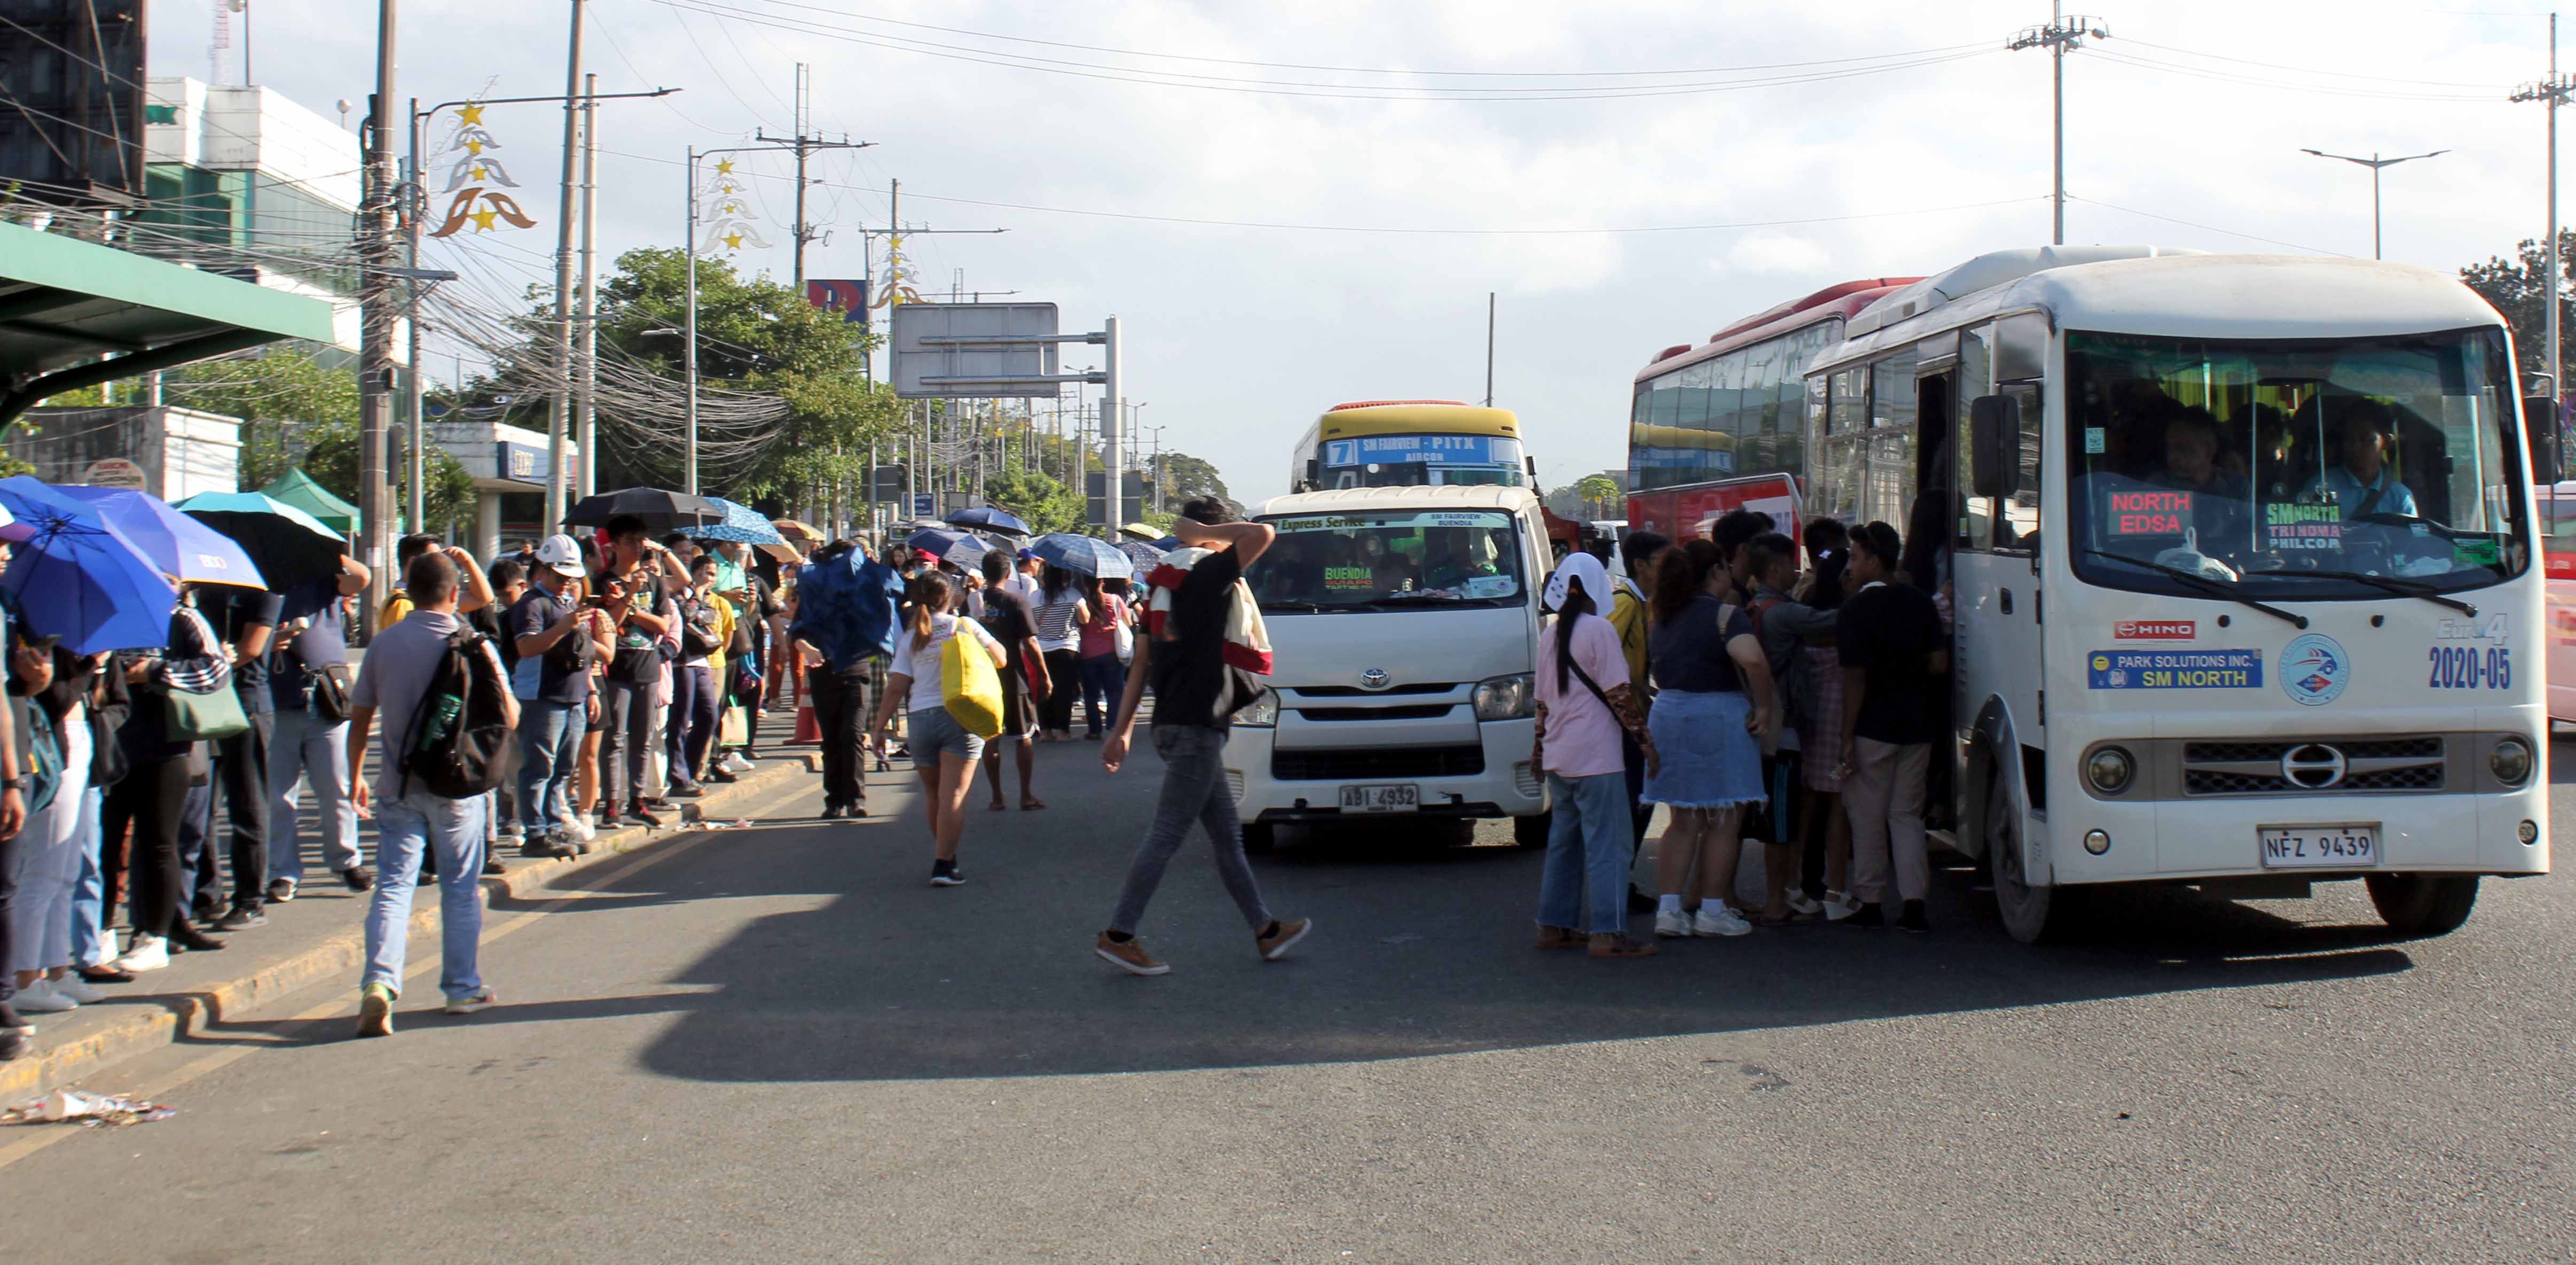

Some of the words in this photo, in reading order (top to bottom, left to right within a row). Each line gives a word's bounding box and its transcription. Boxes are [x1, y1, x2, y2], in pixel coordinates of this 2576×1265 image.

[1379, 437, 1419, 450] FAIRVIEW
[1432, 436, 1475, 449] PITX
[1333, 444, 1349, 464] 7
[1405, 452, 1444, 462] AIRCON
[2112, 493, 2190, 511] NORTH
[1282, 520, 1322, 532] Express
[1326, 517, 1365, 527] Service
[2121, 514, 2182, 533] EDSA
[1325, 567, 1372, 580] BUENDIA
[2139, 625, 2192, 634] HINO
[2484, 613, 2508, 645] 4
[2118, 655, 2152, 667] PARK
[2155, 655, 2226, 667] SOLUTIONS
[2229, 655, 2253, 667] INC.
[2430, 647, 2511, 689] 2020-05
[2142, 670, 2172, 687] SM
[2178, 670, 2247, 686] NORTH
[1378, 787, 1415, 805] 4932
[2267, 838, 2306, 857] NFZ
[2320, 836, 2369, 856] 9439
